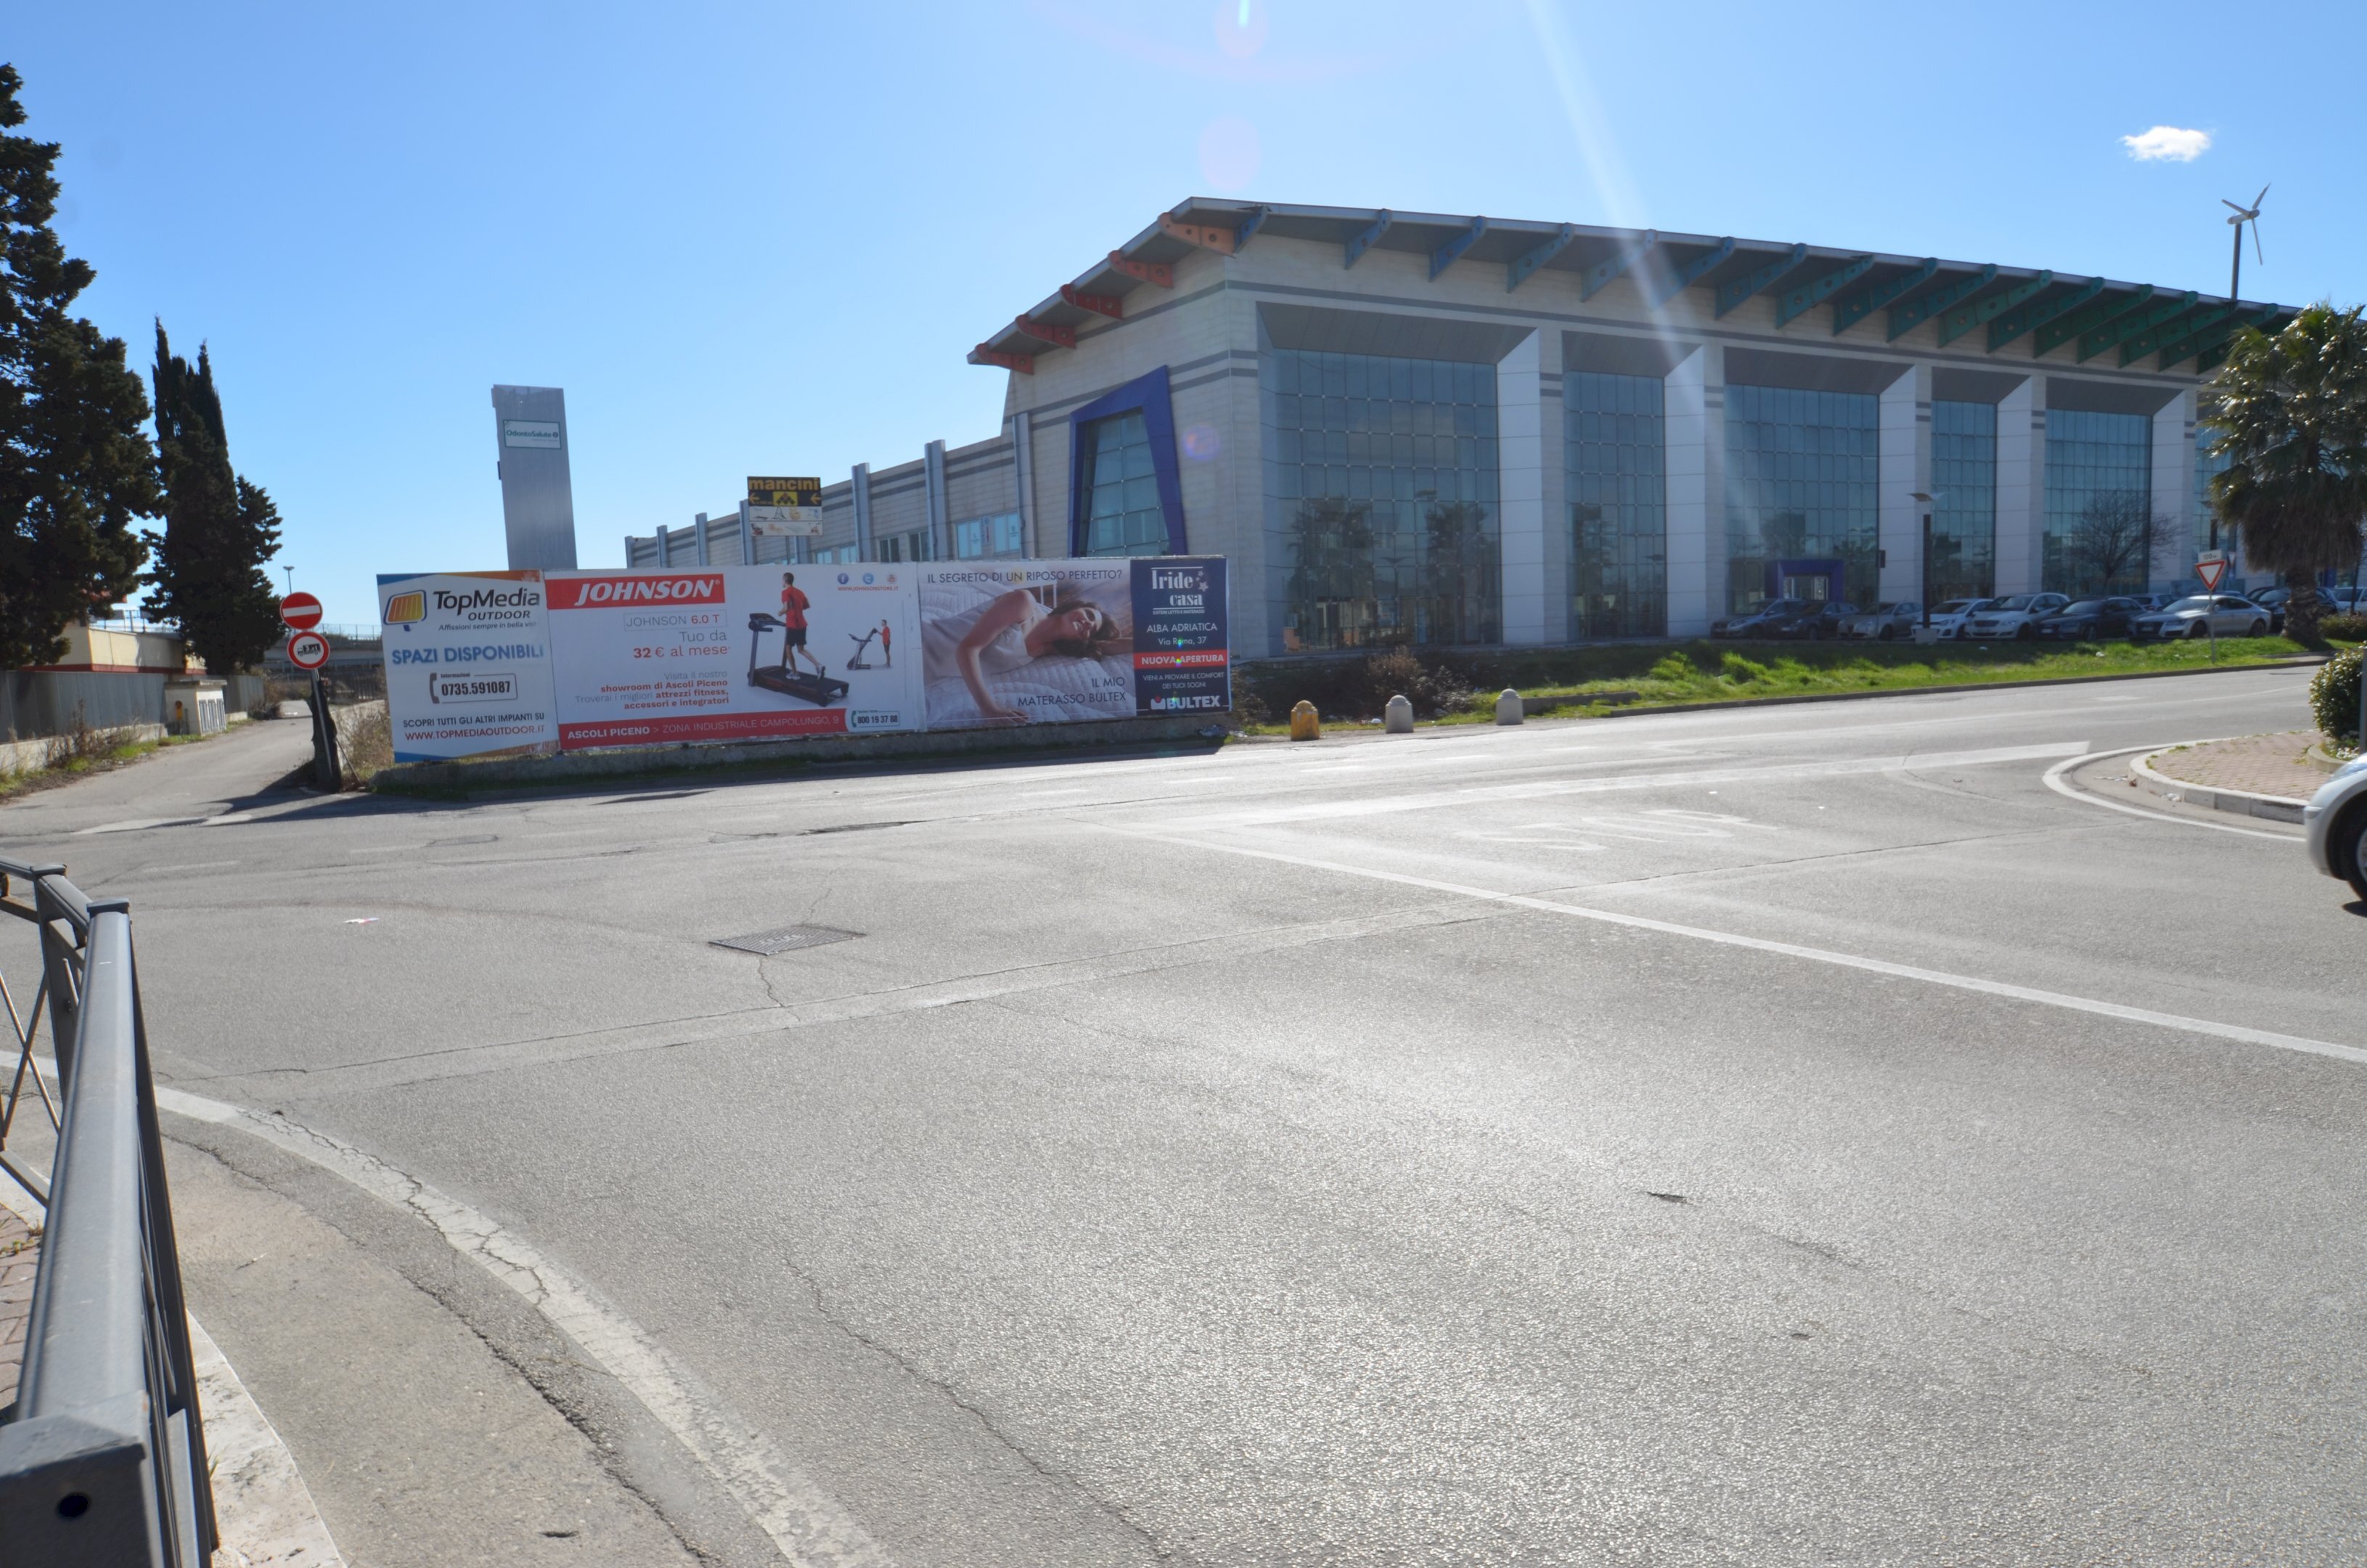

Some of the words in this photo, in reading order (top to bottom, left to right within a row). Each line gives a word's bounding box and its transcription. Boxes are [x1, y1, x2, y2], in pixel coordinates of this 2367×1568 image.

[749, 478, 819, 490] mancini
[928, 573, 936, 583] IL
[939, 572, 989, 583] SEGRETO
[992, 572, 1002, 581] DI
[1006, 572, 1023, 581] UN
[1026, 571, 1066, 581] RIPOSO
[1068, 569, 1122, 580] PERFETTO?
[1152, 570, 1193, 589] Iride
[433, 587, 540, 616] TopMedia
[1169, 594, 1203, 606] casa
[468, 611, 531, 621] OUTDOOR
[626, 616, 687, 627] JOHNSON
[691, 614, 708, 624] 6.0
[712, 614, 720, 623] T
[1147, 624, 1169, 633] ALBA
[1172, 623, 1217, 632] ADRIATICA
[679, 630, 704, 642] Tuo
[709, 629, 727, 641] da
[392, 648, 438, 665] SPAZI
[444, 644, 544, 662] DISPONIBILI
[634, 648, 651, 658] 32
[655, 647, 664, 658] €
[671, 645, 684, 657] al
[1142, 656, 1176, 665] NUOVA
[663, 671, 688, 679] Visita
[441, 681, 510, 696] 0735.591087
[601, 682, 651, 693] showroom
[666, 681, 694, 690] Ascoli
[1092, 678, 1100, 688] IL
[1103, 677, 1125, 687] MIO
[575, 694, 613, 703] Troverai
[620, 692, 653, 703] migliori
[655, 690, 691, 699] attrezzi
[694, 688, 729, 697] fitness,
[1018, 694, 1086, 706] MATERASSO
[1090, 691, 1127, 703] BULTEX
[1166, 695, 1221, 709] BULTEX
[624, 700, 669, 710] accessori
[679, 697, 729, 709] integratori
[403, 717, 435, 727] SCOPRI
[437, 716, 457, 726] TUTTI
[459, 716, 473, 724] GLI
[475, 714, 496, 724] ALTRI
[498, 713, 533, 723] IMPIANTI
[890, 714, 899, 723] 88
[405, 724, 545, 740] WWW.TOPMEDIAOUTDOOR.IT
[568, 729, 607, 740] ASCOLI
[610, 726, 650, 737] PICENO
[662, 724, 691, 733] ZONA
[693, 719, 756, 731] INDUSTRIALE
[833, 716, 839, 724] 9
